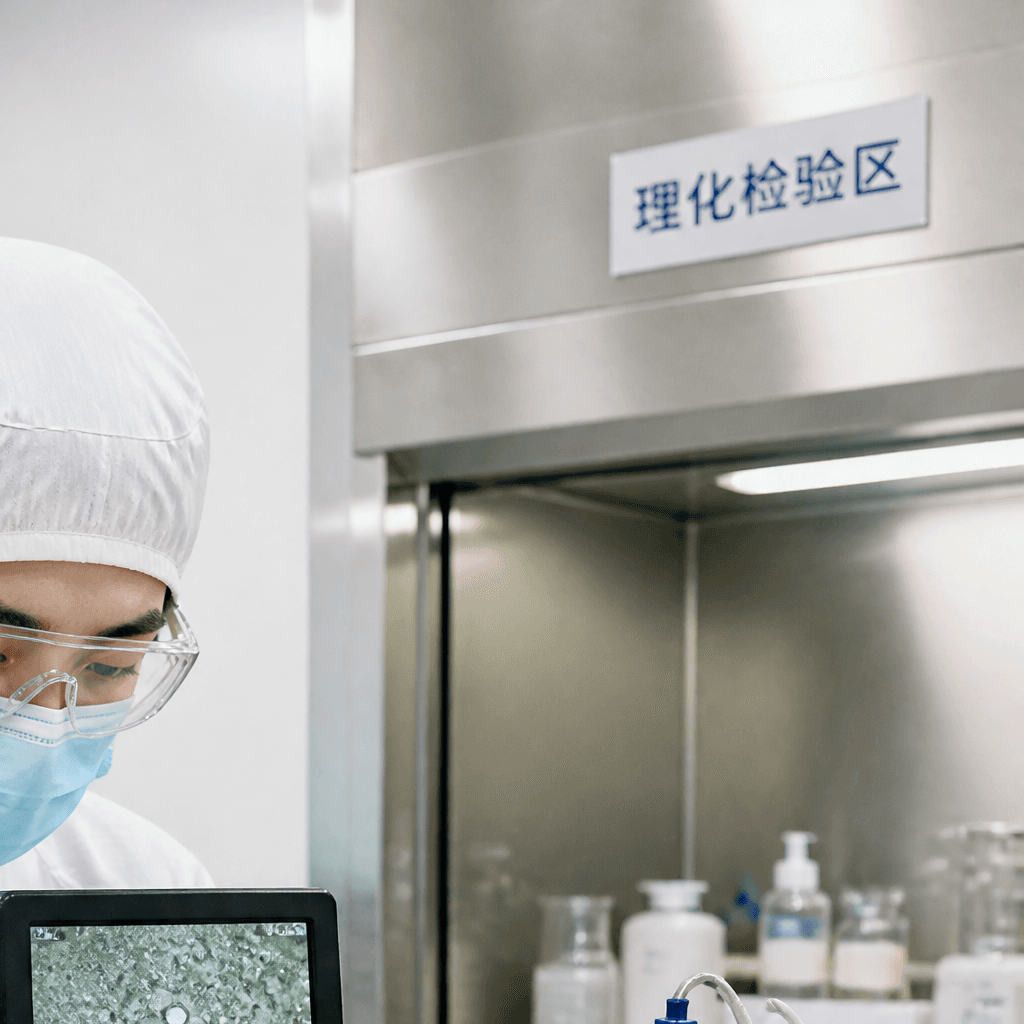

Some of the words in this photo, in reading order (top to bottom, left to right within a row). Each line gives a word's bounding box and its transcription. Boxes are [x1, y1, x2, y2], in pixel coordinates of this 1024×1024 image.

[633, 138, 902, 233] 理化检验区
